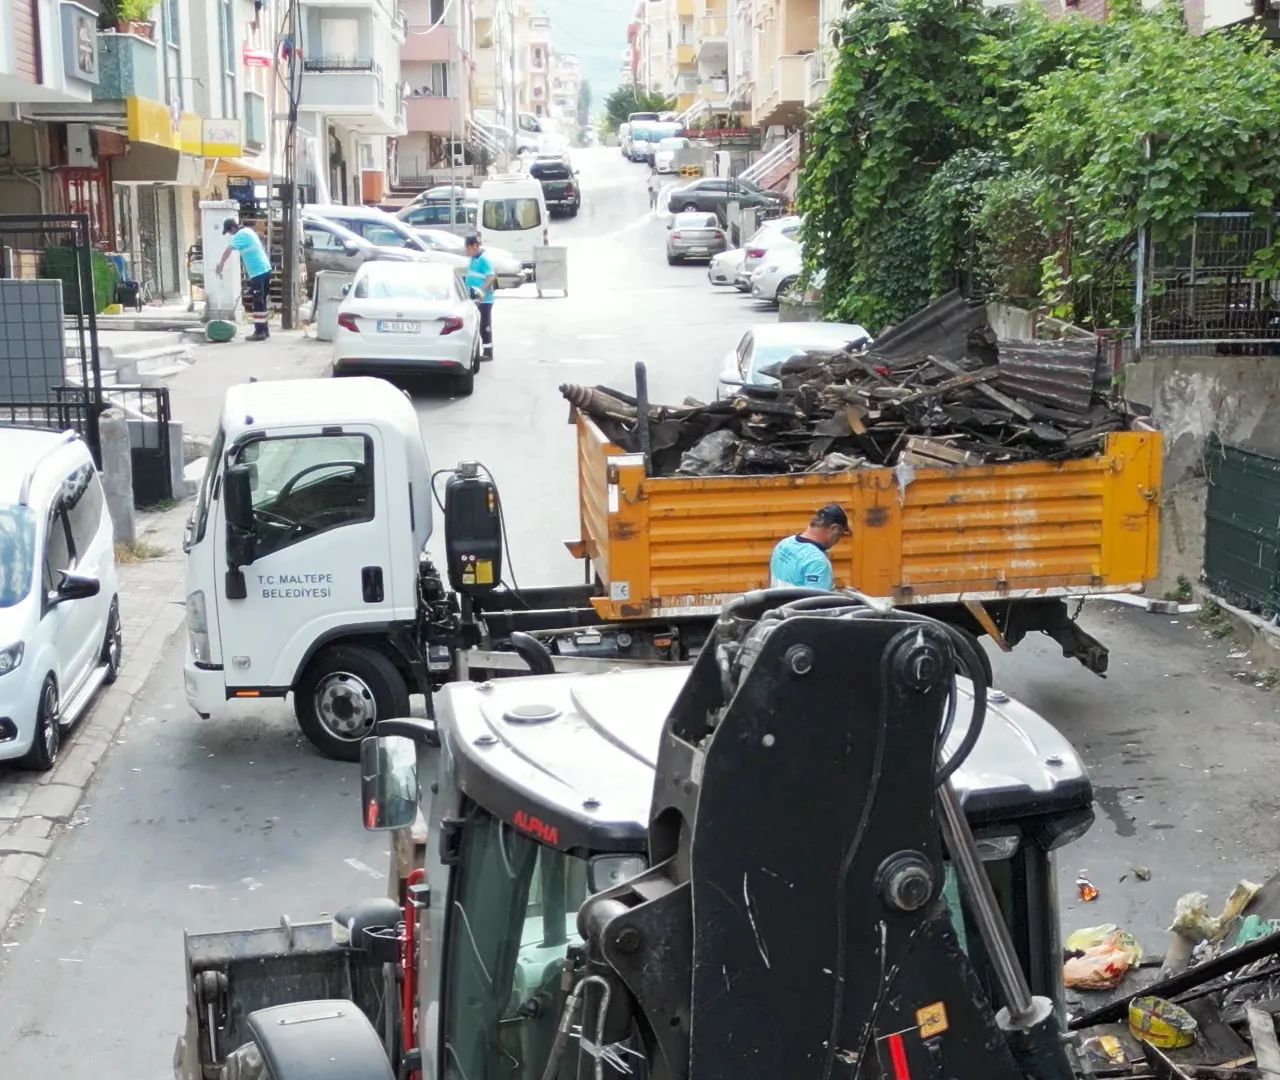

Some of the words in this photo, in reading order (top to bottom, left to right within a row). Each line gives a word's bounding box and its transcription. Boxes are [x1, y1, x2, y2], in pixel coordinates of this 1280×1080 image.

[279, 574, 333, 585] MALTEPE
[262, 586, 331, 598] BELEDİYESİ
[513, 809, 559, 845] ALPHA
